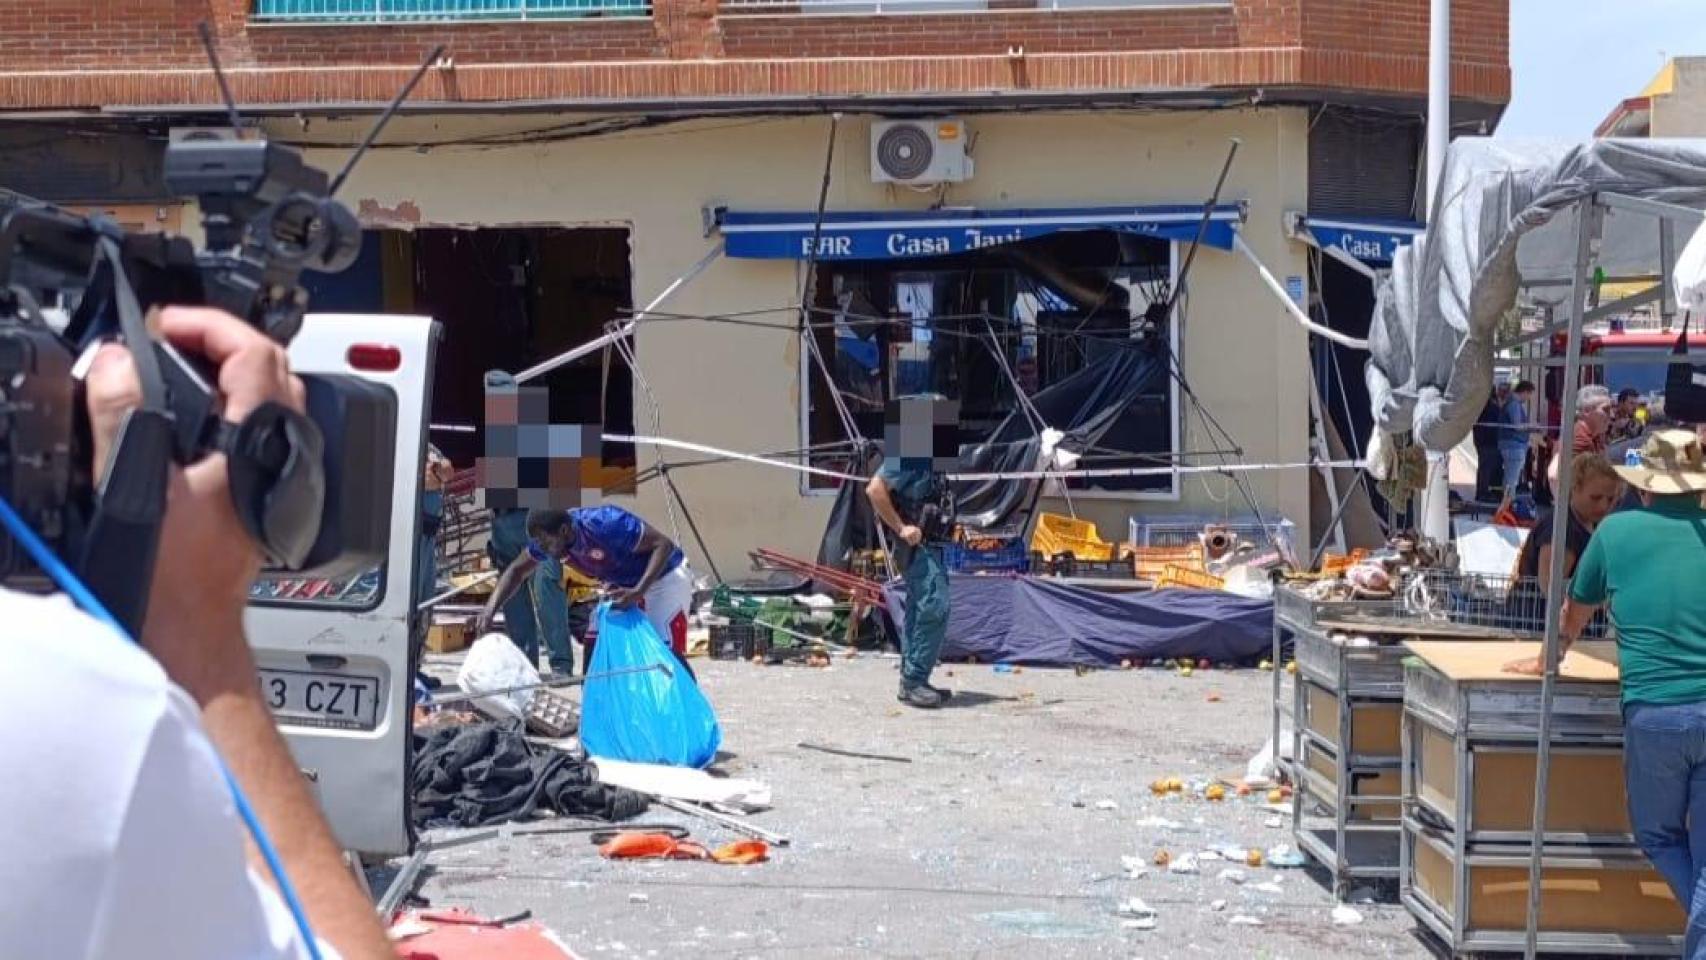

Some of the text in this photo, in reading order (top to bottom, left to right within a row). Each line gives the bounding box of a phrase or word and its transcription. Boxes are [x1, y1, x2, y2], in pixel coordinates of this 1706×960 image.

[801, 235, 851, 256] BAR
[887, 233, 950, 256] Casa
[1342, 233, 1381, 258] Casa
[305, 680, 368, 716] CZT
